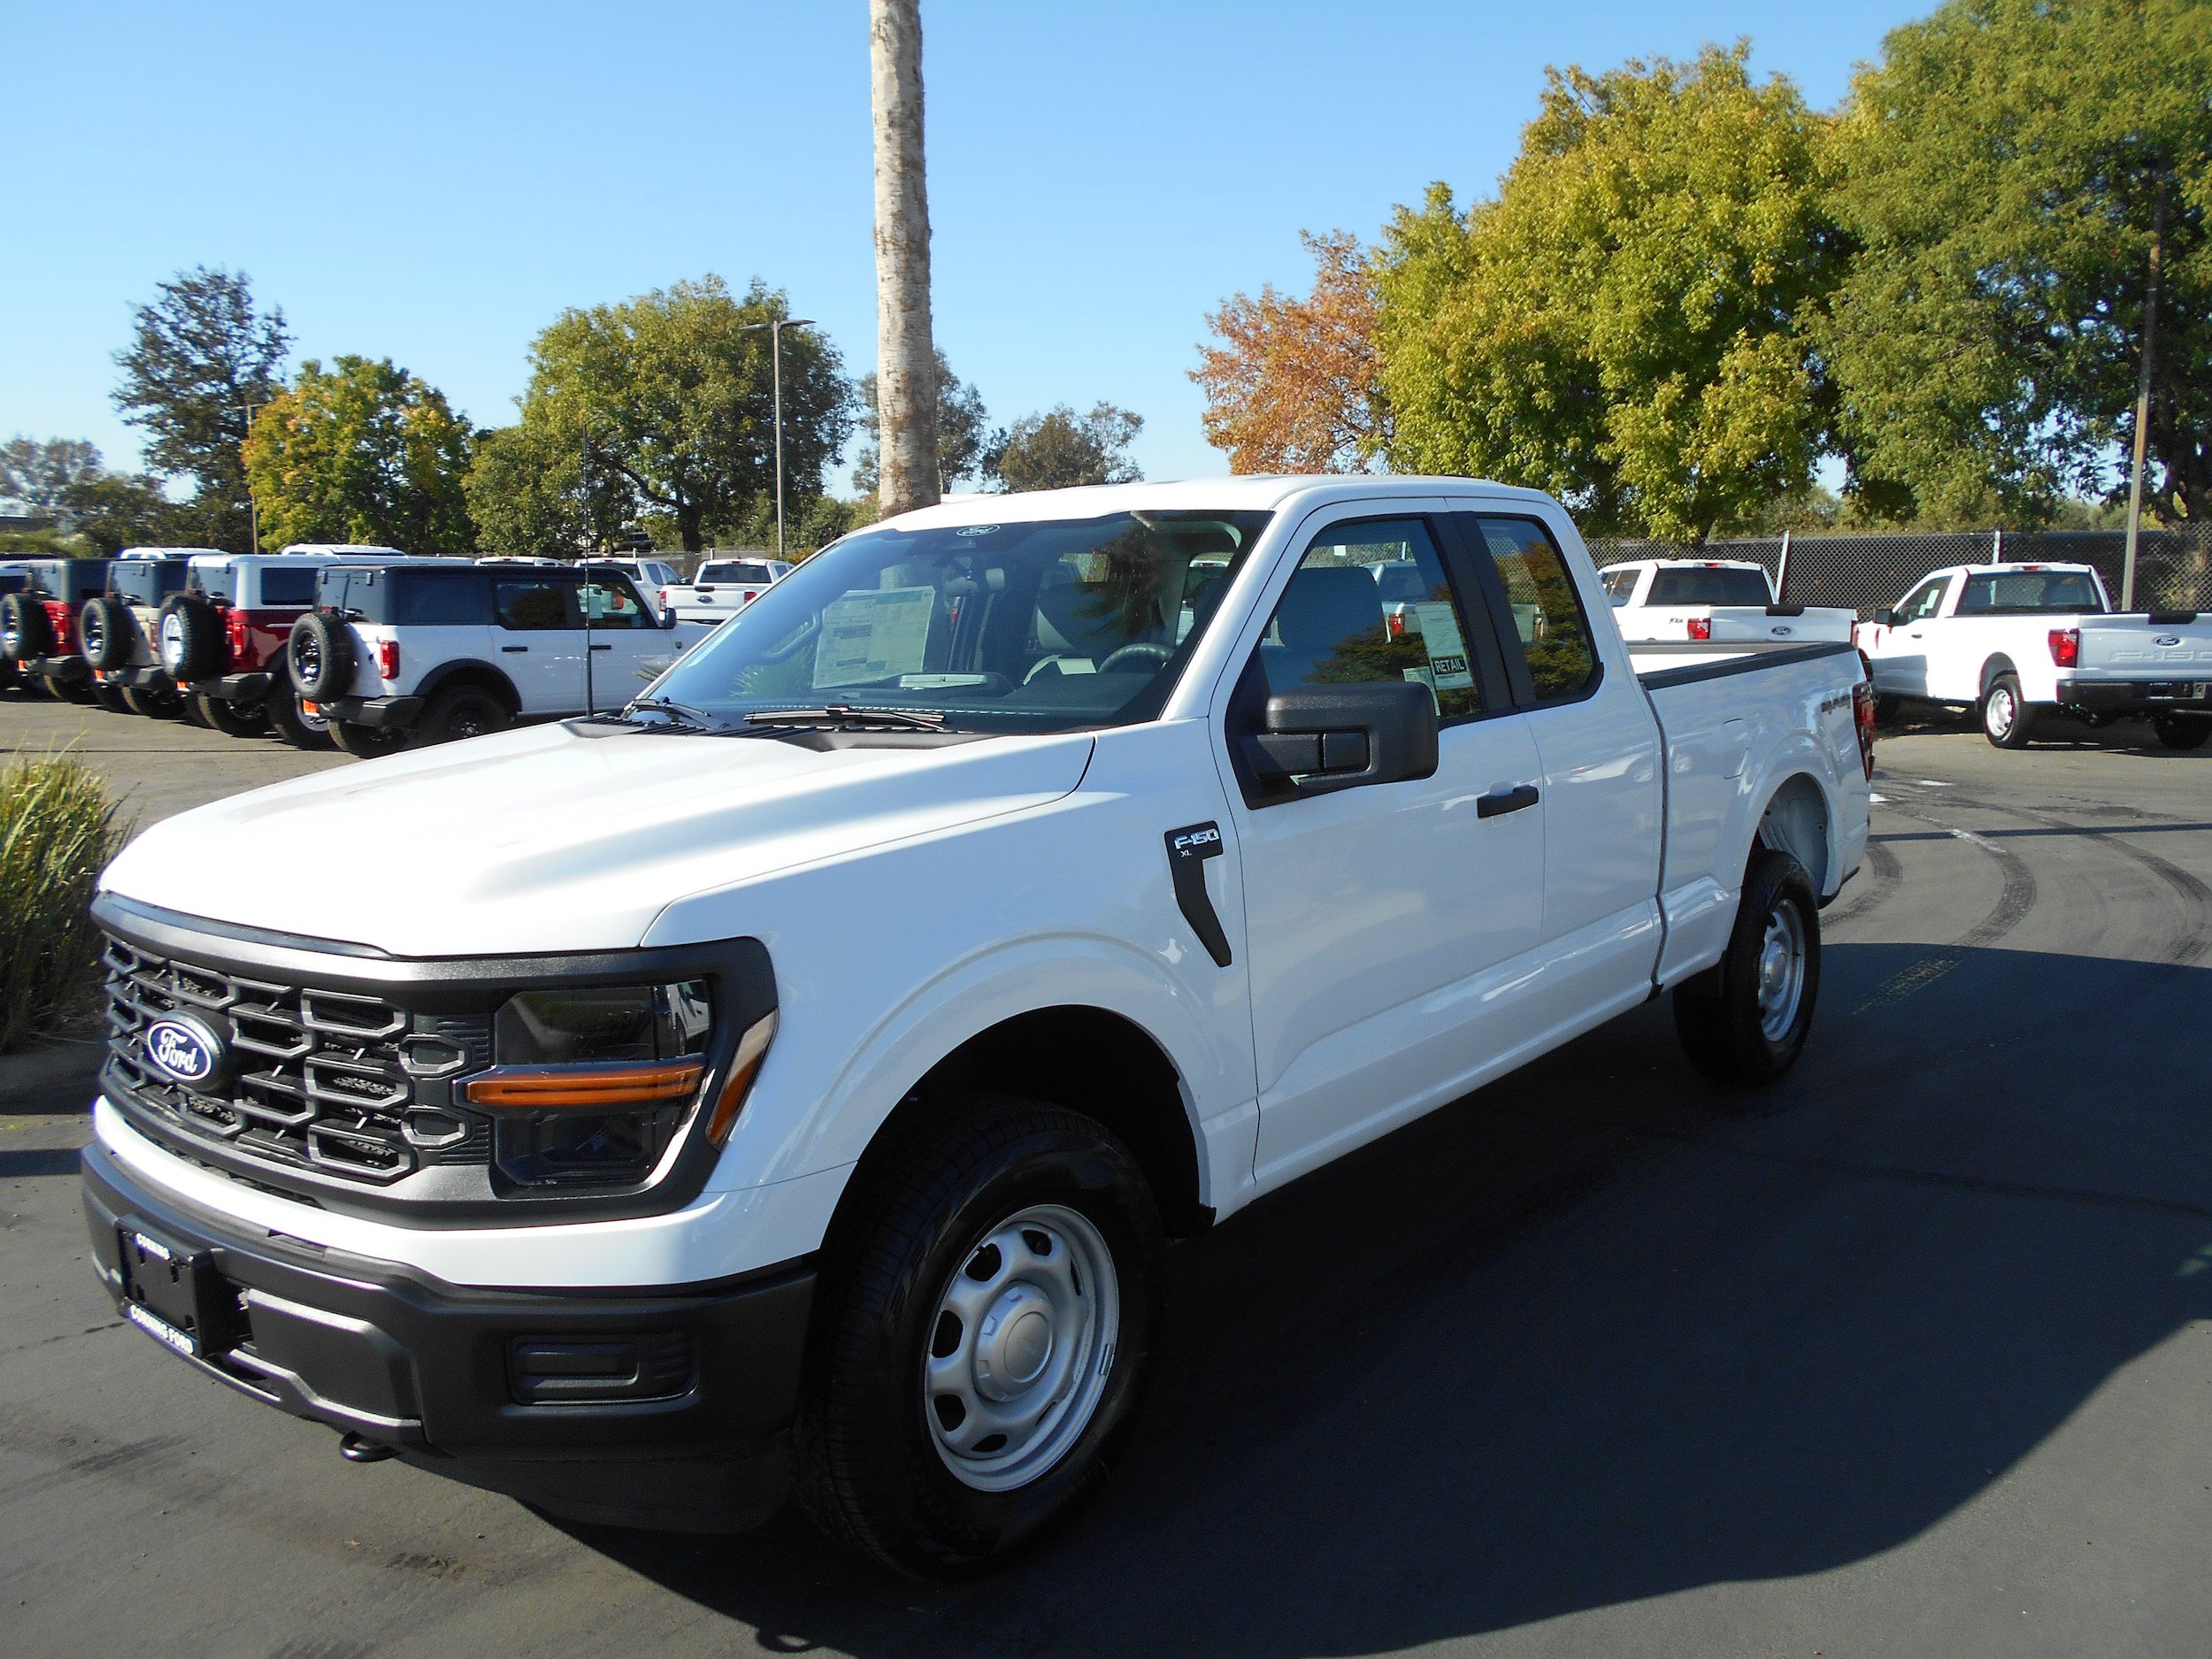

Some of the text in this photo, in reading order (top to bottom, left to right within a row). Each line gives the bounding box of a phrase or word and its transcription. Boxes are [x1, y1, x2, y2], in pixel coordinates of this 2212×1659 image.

[1434, 658, 1465, 673] RETAIL
[1174, 828, 1219, 850] F-150
[1180, 849, 1193, 858] XL
[157, 1028, 199, 1073] Ford
